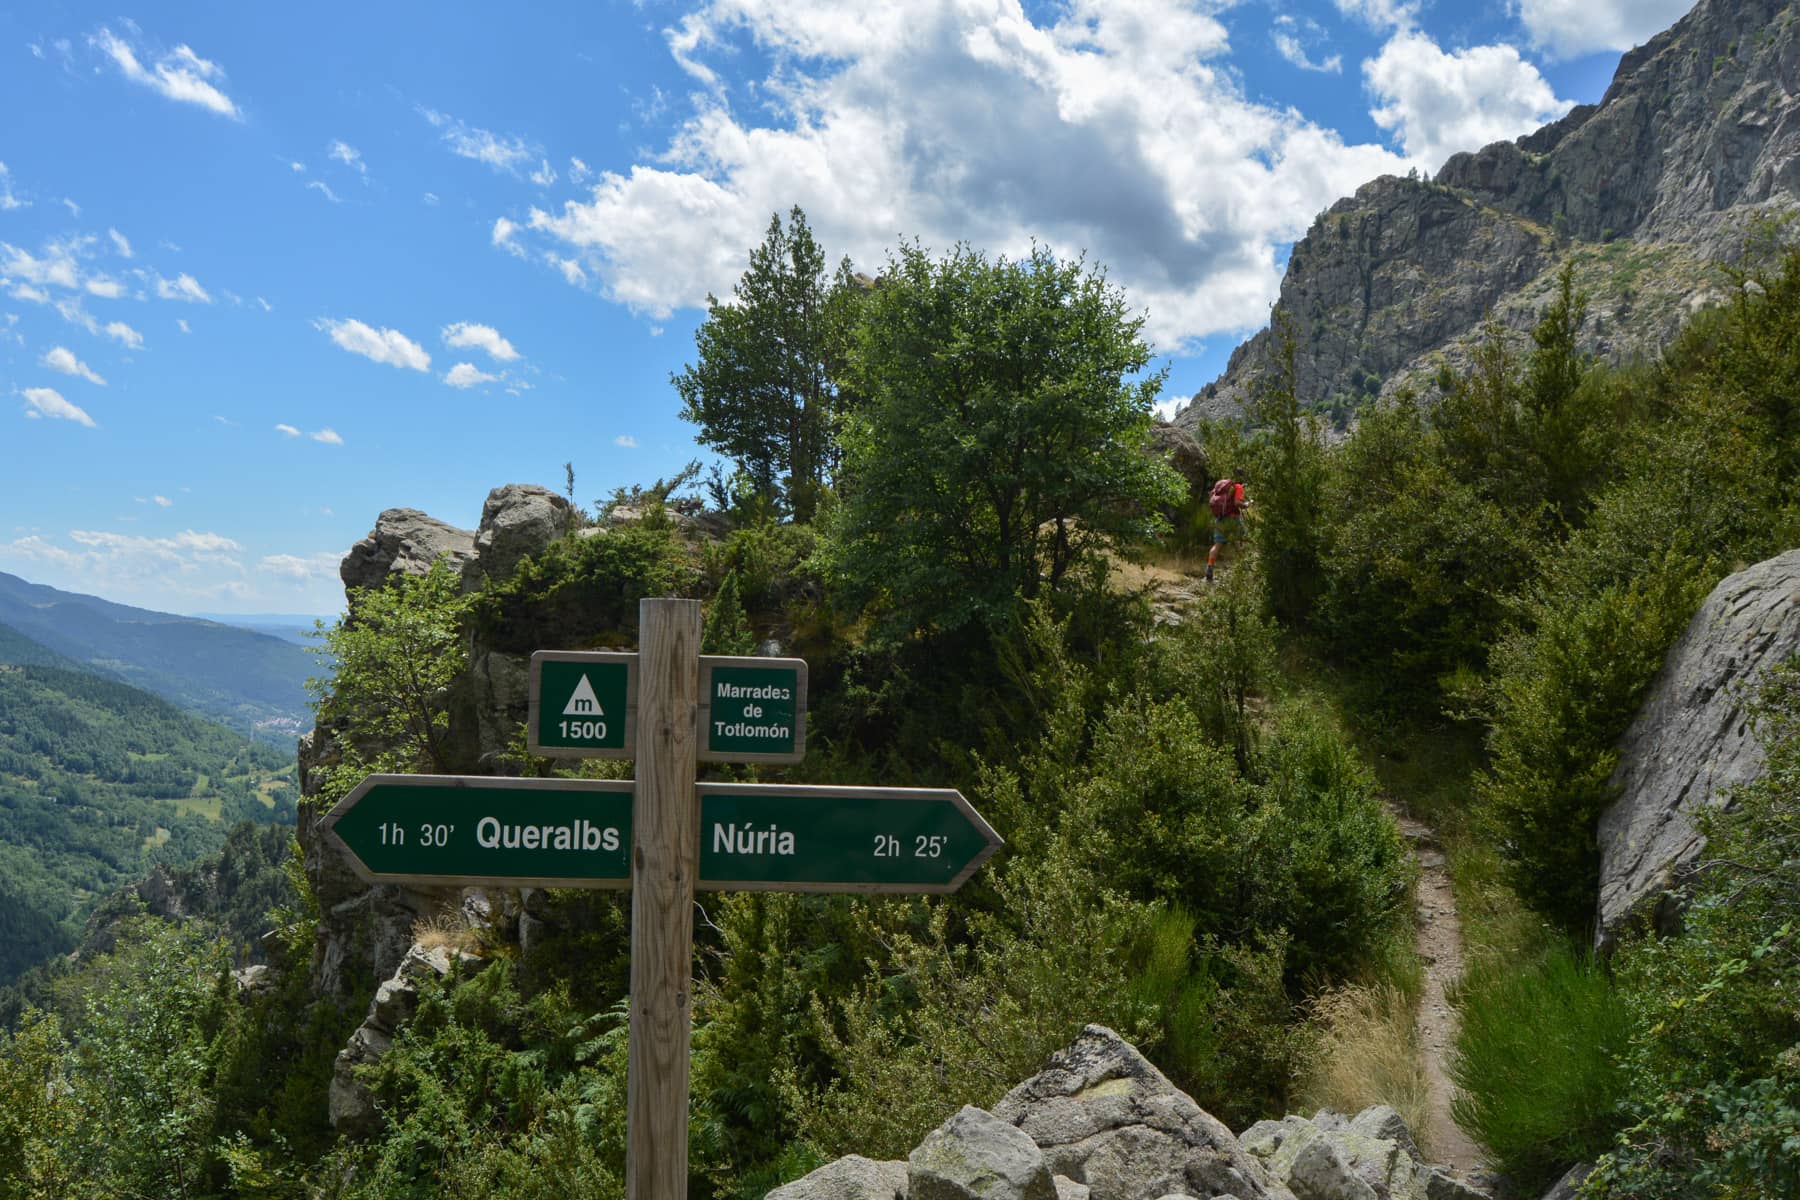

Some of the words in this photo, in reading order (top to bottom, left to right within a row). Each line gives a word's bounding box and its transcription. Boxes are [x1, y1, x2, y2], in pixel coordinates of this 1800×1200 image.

[574, 697, 593, 712] m
[743, 704, 762, 718] de
[559, 721, 607, 739] 1500
[715, 721, 789, 739] Totlomón
[379, 823, 404, 845] 1h
[420, 824, 454, 846] 30'
[476, 817, 620, 853] Queralbs
[713, 822, 794, 855] Núria
[874, 835, 900, 857] 2h
[915, 836, 948, 858] 25'
